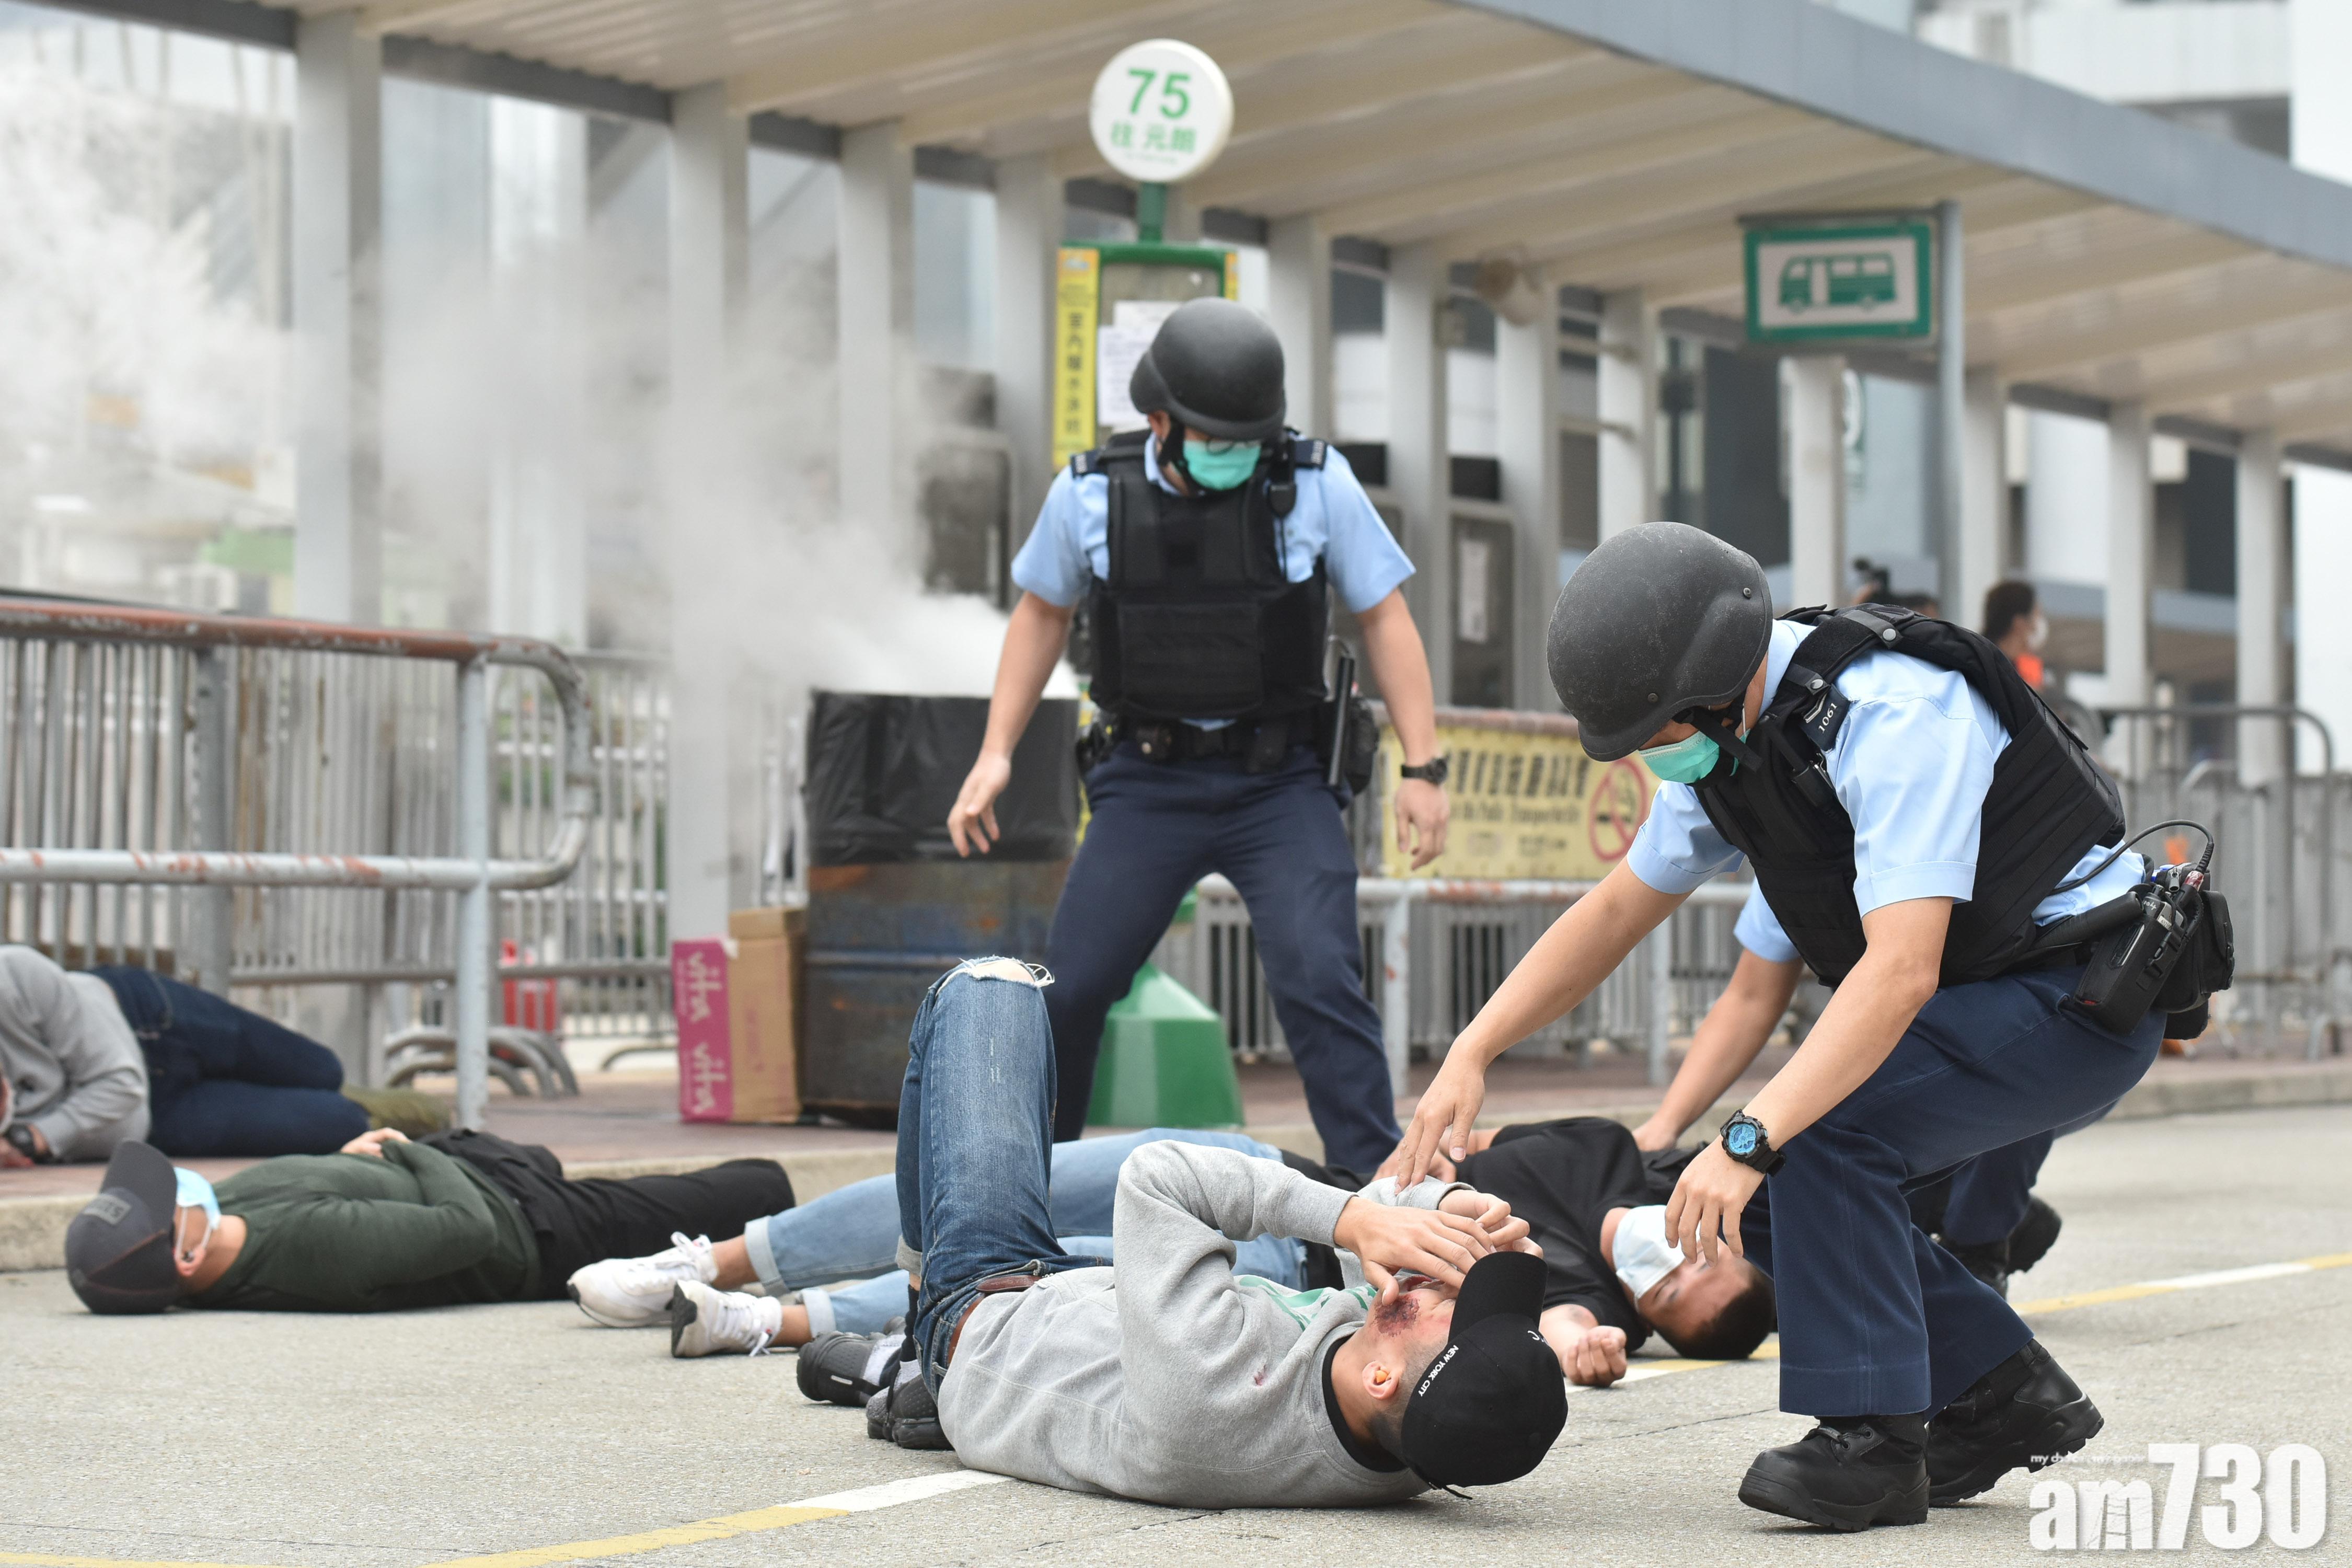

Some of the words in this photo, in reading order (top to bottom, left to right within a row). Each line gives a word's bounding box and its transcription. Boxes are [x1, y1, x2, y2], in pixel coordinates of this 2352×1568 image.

[1128, 67, 1191, 119] 75
[1818, 702, 1838, 734] 1061
[1444, 1345, 1459, 1363] NEW
[1428, 1361, 1446, 1381] YORK
[1418, 1380, 1430, 1397] CITY
